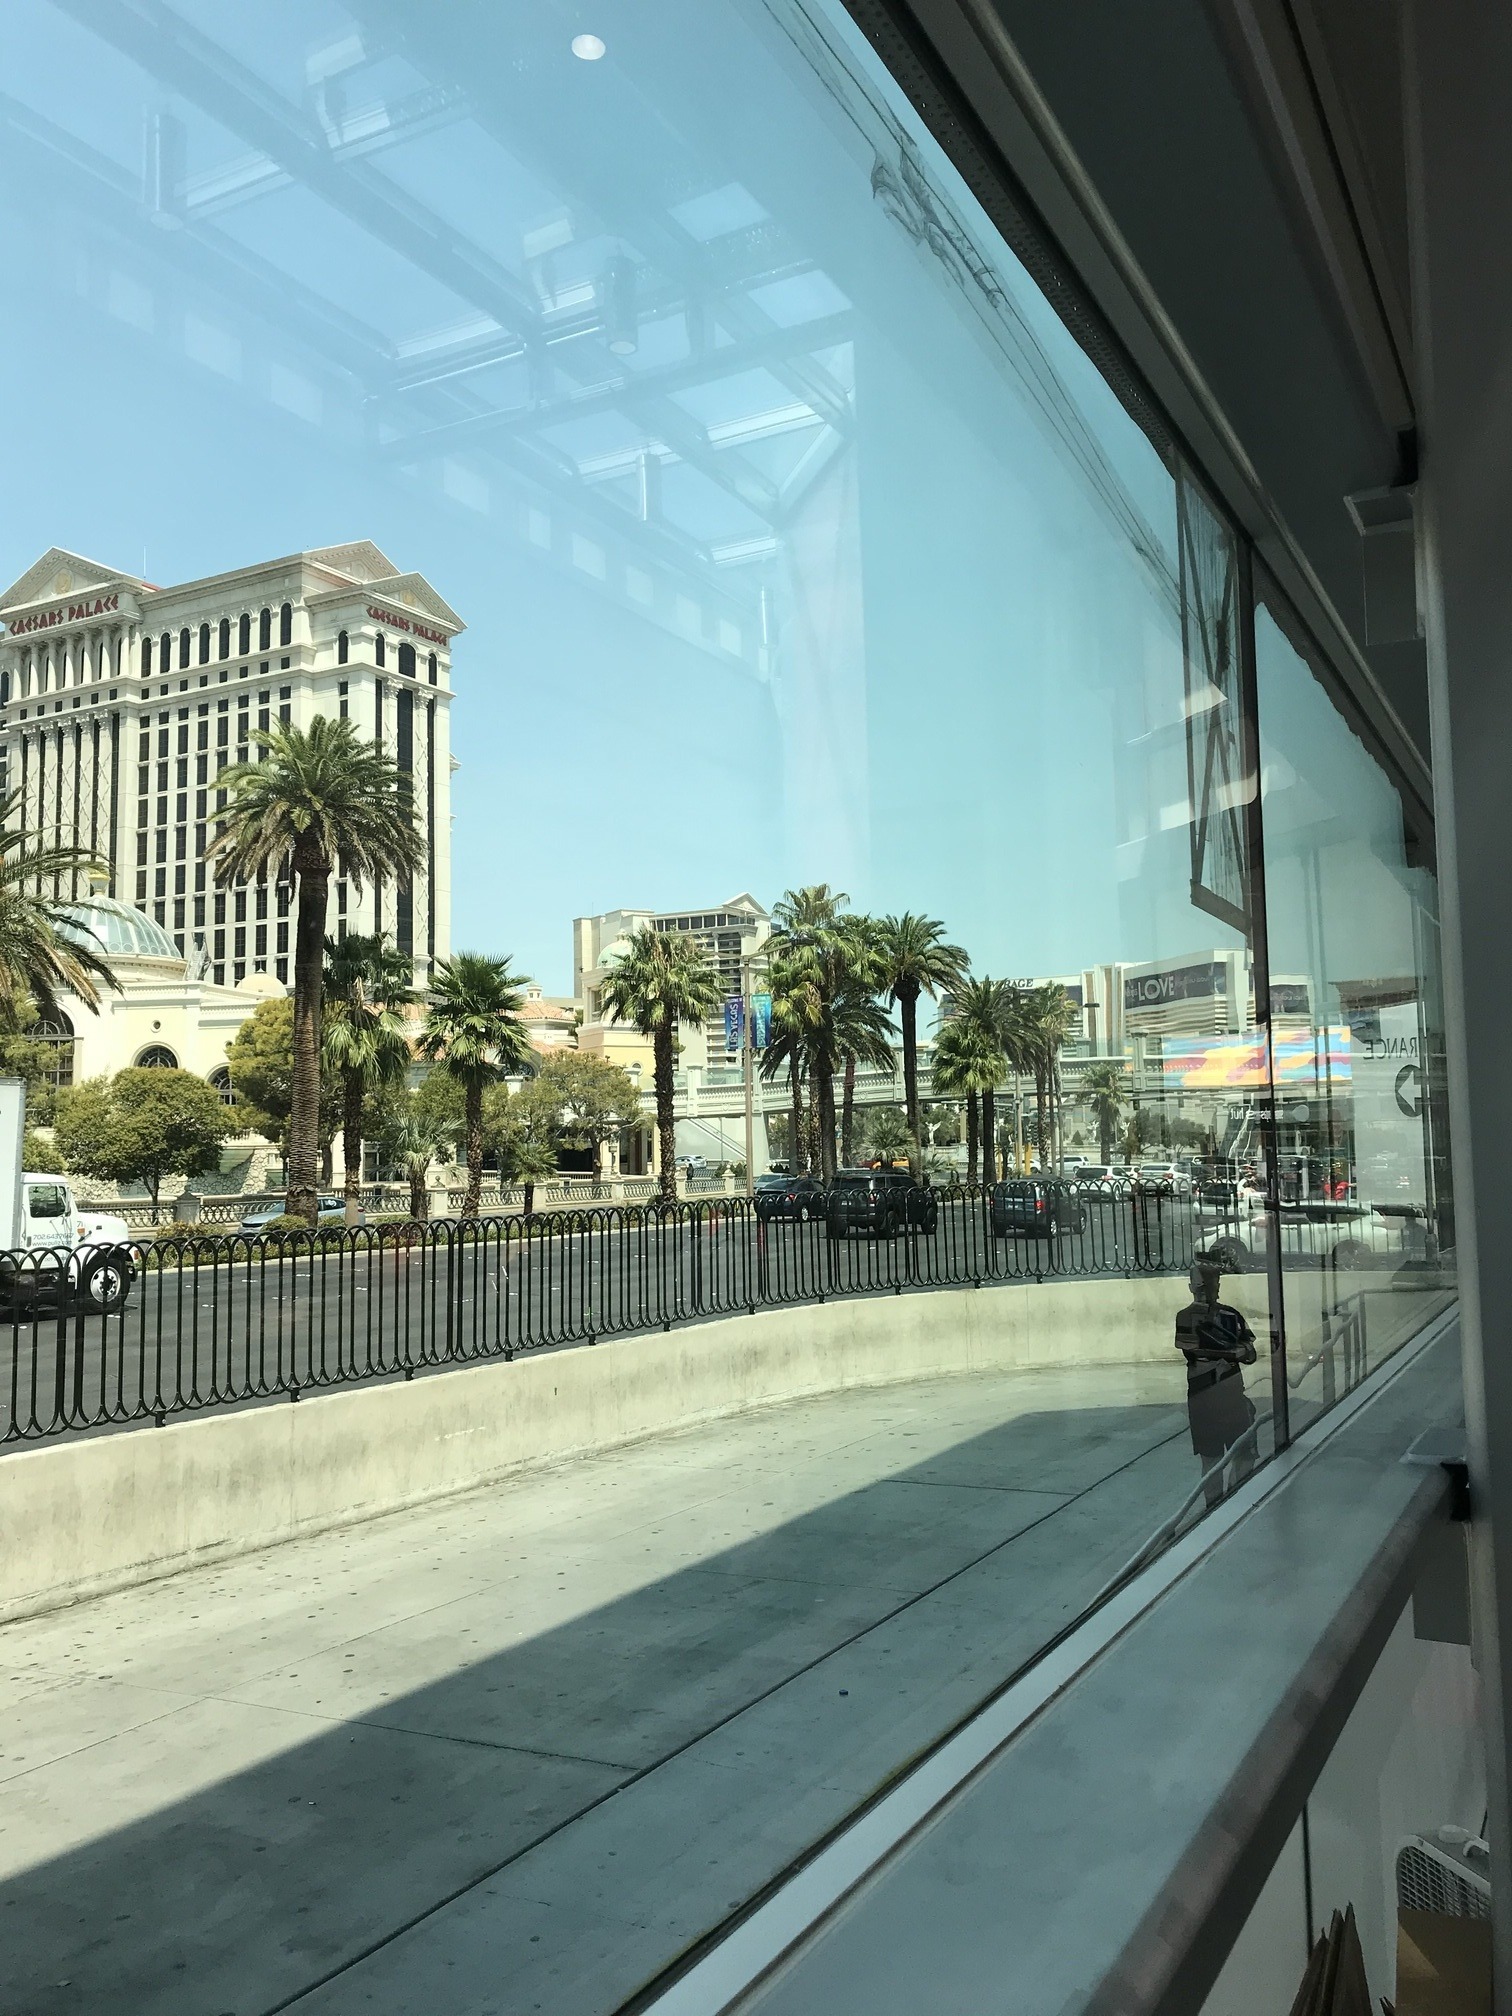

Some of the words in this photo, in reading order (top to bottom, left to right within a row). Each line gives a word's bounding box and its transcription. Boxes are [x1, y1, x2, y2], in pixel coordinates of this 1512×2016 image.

[9, 609, 64, 636] CAESARS
[68, 593, 119, 621] PALACE
[366, 605, 410, 632] CAESARS
[413, 622, 447, 646] PALACE
[1138, 975, 1175, 1001] LOVE
[729, 1003, 738, 1030] VEGAS
